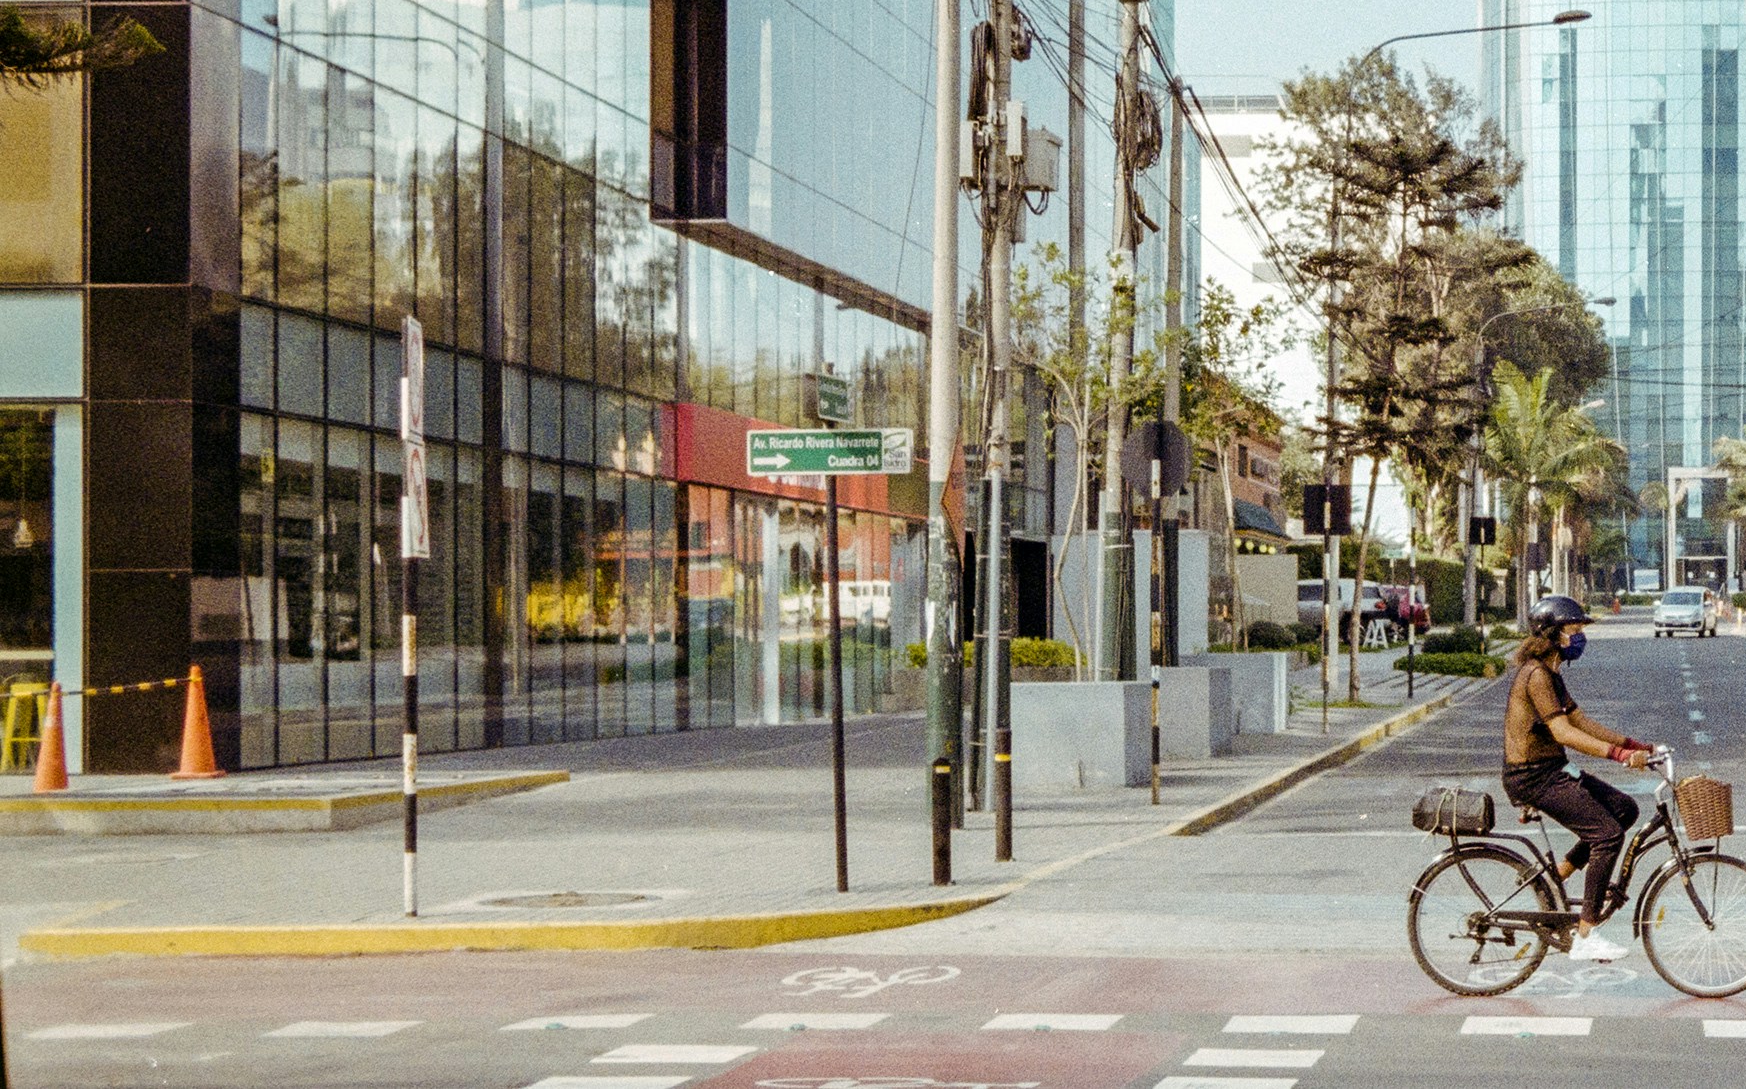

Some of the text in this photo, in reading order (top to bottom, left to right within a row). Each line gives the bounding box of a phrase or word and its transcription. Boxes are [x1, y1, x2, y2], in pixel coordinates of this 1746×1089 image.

[753, 436, 879, 449] Av. Ricardo Rivera Navarrete
[828, 454, 879, 467] Cuadra 04
